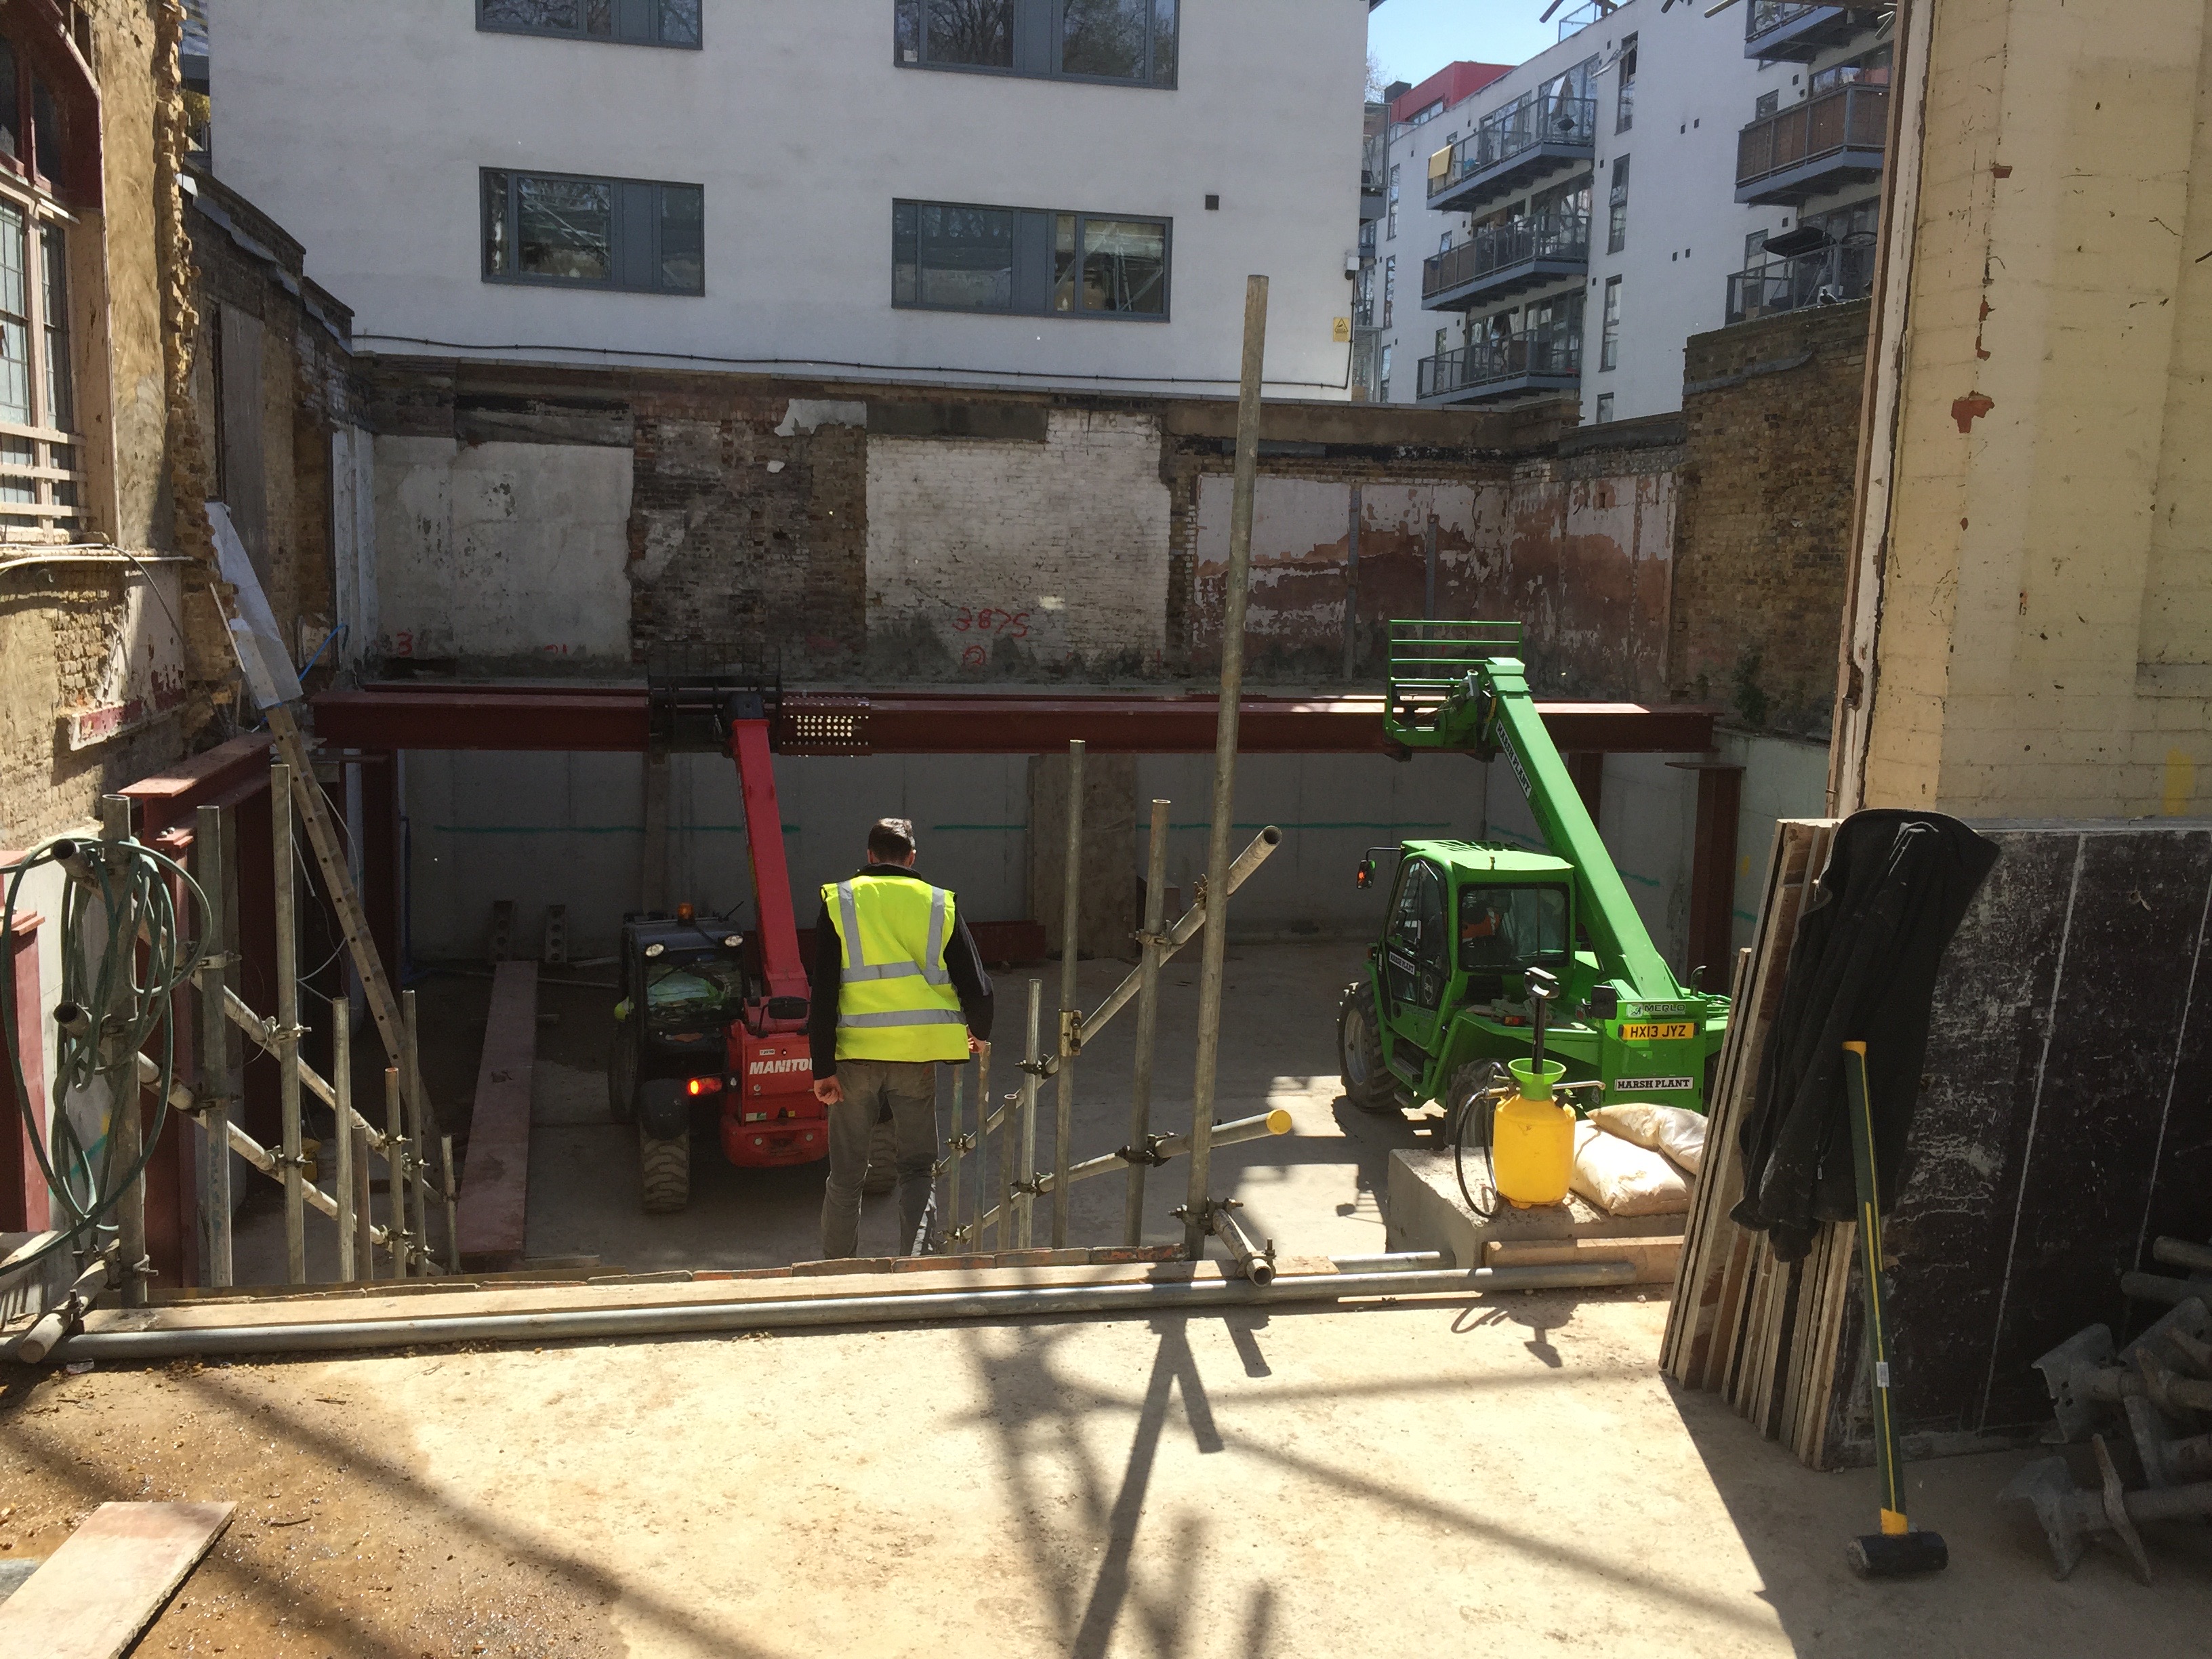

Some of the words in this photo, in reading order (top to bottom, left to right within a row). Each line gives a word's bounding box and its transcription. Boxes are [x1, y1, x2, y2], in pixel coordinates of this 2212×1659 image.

[1512, 757, 1531, 793] PLANT
[1644, 1004, 1685, 1012] MERLO
[1630, 1026, 1658, 1038] HX13
[1662, 1025, 1686, 1037] JYZ
[1617, 1080, 1654, 1089] MARSH
[1654, 1079, 1690, 1088] PLANT
